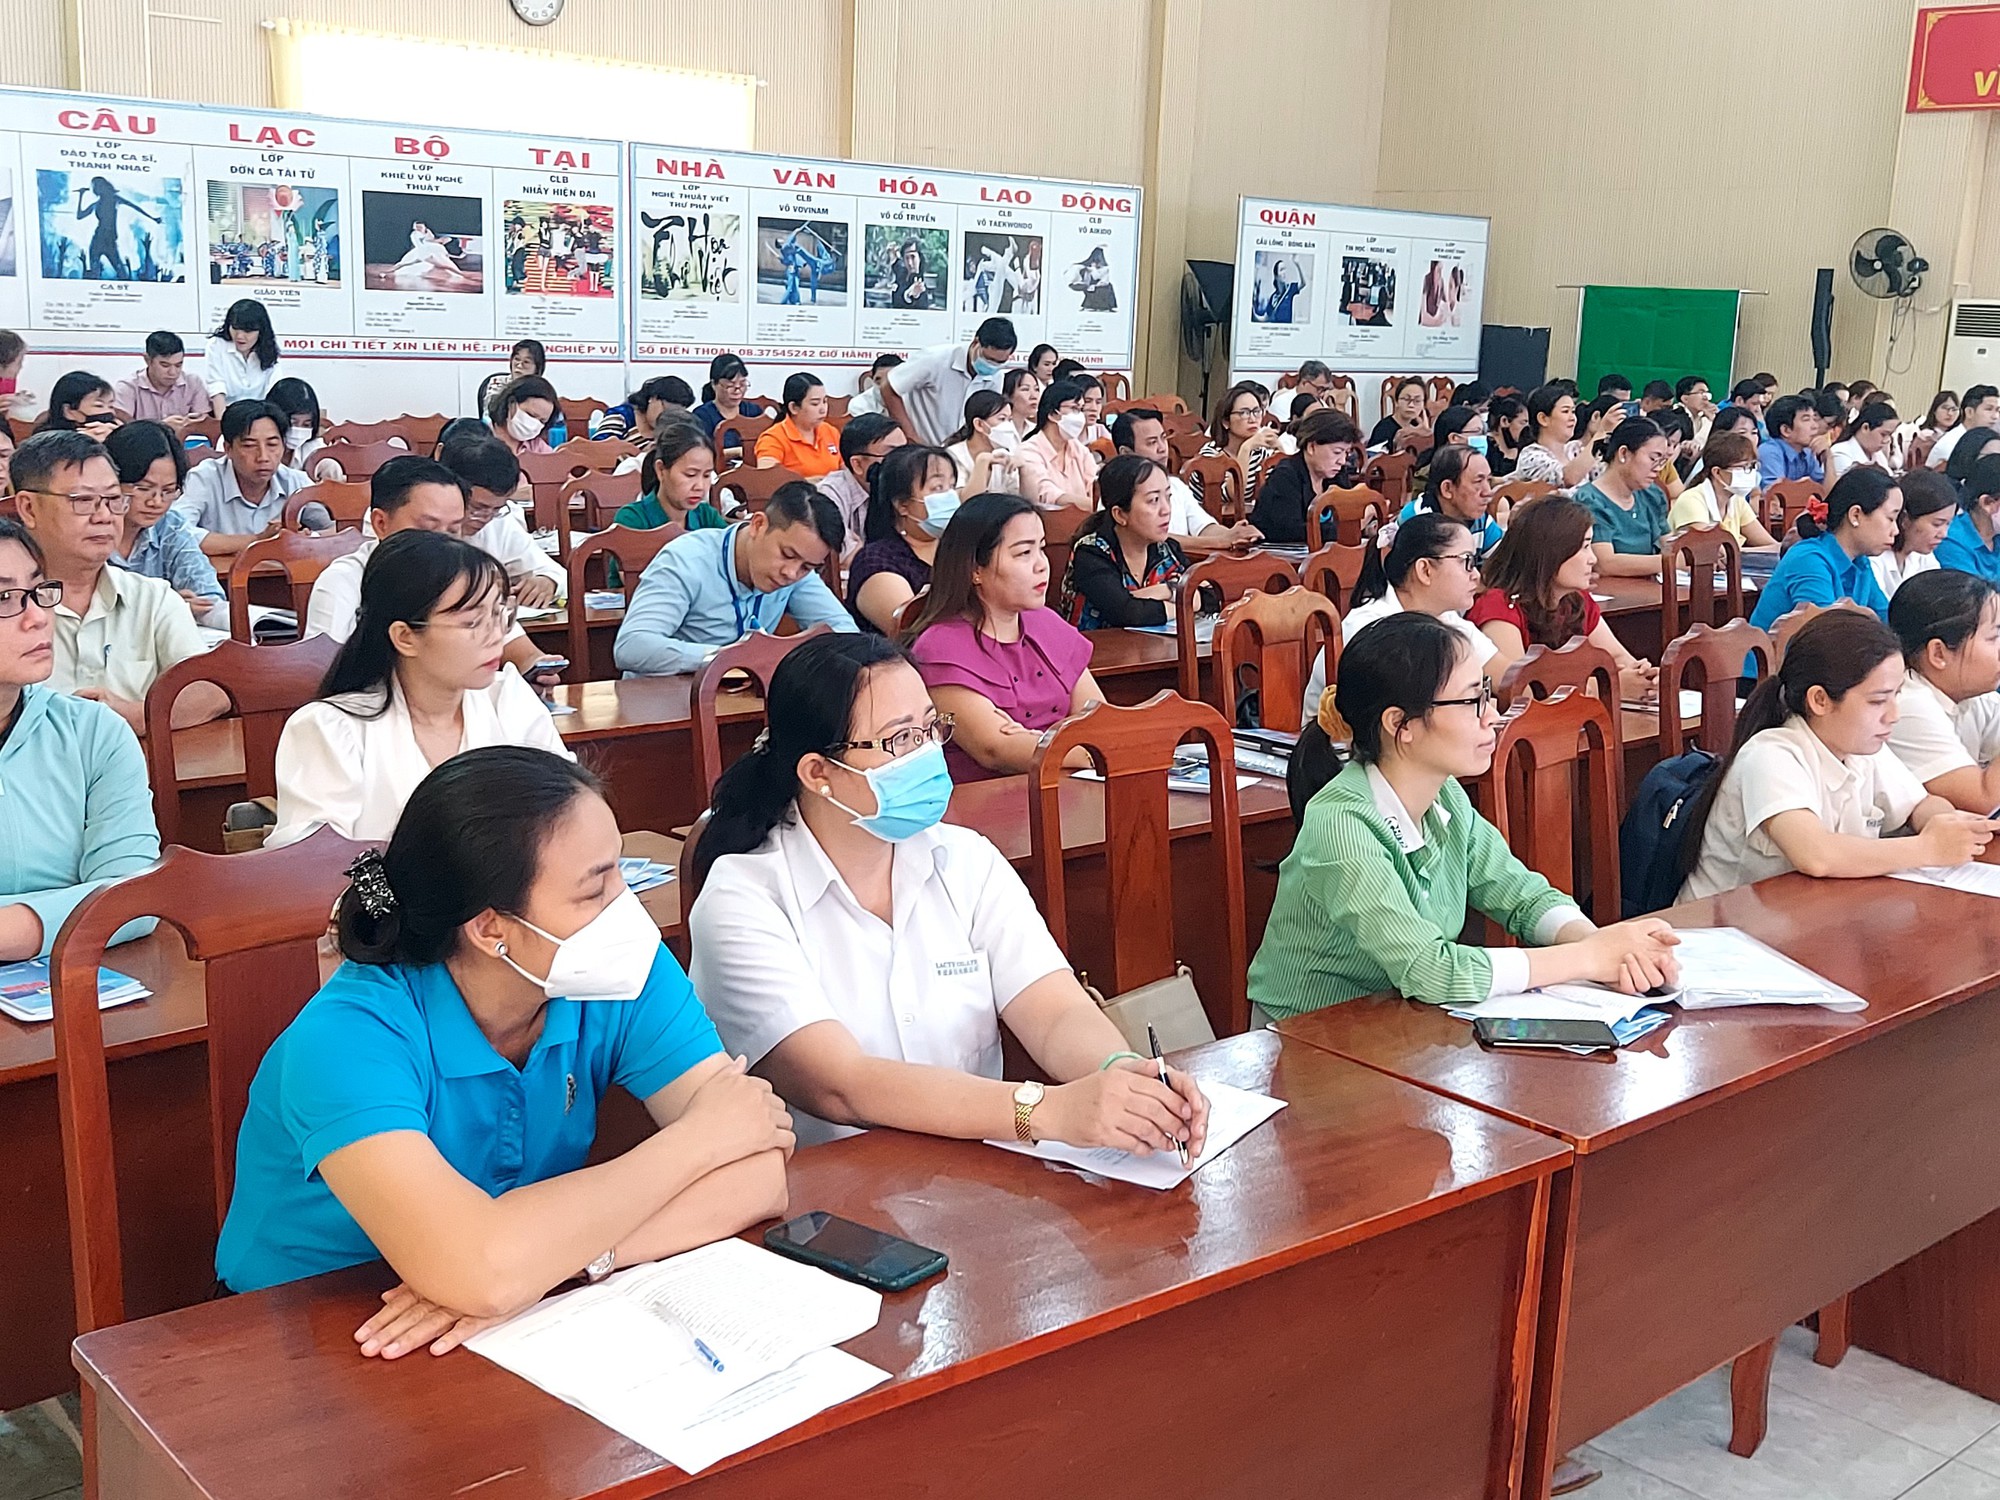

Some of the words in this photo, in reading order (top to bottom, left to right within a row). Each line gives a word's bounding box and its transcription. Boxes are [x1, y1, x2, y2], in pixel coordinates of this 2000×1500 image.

[58, 108, 156, 134] CÂU
[229, 123, 316, 148] LẠC
[395, 135, 450, 160] BỘ
[528, 148, 590, 170] TẠI
[121, 153, 138, 161] CA
[68, 160, 111, 170] THANH
[258, 167, 273, 176] CA
[549, 175, 569, 183] CLB
[657, 158, 725, 179] NHÀ
[773, 167, 835, 188] VĂN
[879, 176, 938, 197] HÓA
[981, 187, 1032, 204] LAO
[1061, 192, 1132, 213] ĐỘNG
[796, 194, 812, 202] CLB
[792, 205, 829, 215] VOVINAM
[901, 202, 916, 210] CLB
[1260, 208, 1316, 227] QUẬN
[283, 339, 314, 350] MỌI
[320, 340, 346, 349] CHI
[352, 339, 387, 350] TIẾT
[392, 341, 417, 350] XIN
[423, 340, 457, 351] LIÊN
[738, 349, 816, 357] 08.37545242
